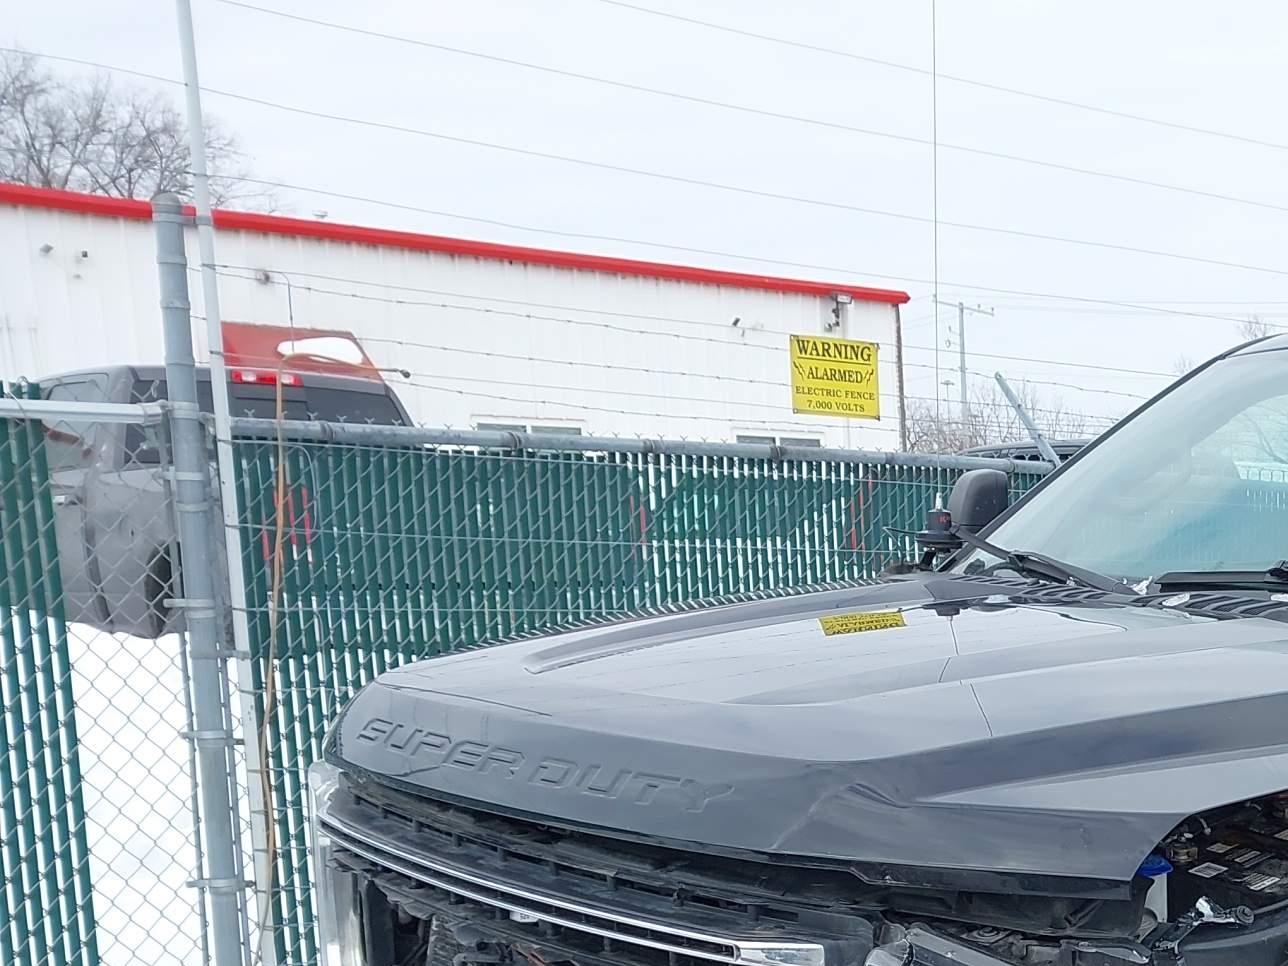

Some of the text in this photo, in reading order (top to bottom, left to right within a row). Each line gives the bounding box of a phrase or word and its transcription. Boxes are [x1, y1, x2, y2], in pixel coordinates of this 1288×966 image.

[796, 339, 872, 362] WARNING
[807, 366, 863, 384] ALARMED
[795, 386, 875, 400] ELECTRIC FENCE
[807, 400, 865, 412] 7,000 VOLTS
[355, 717, 735, 813] SUPER DUTY
